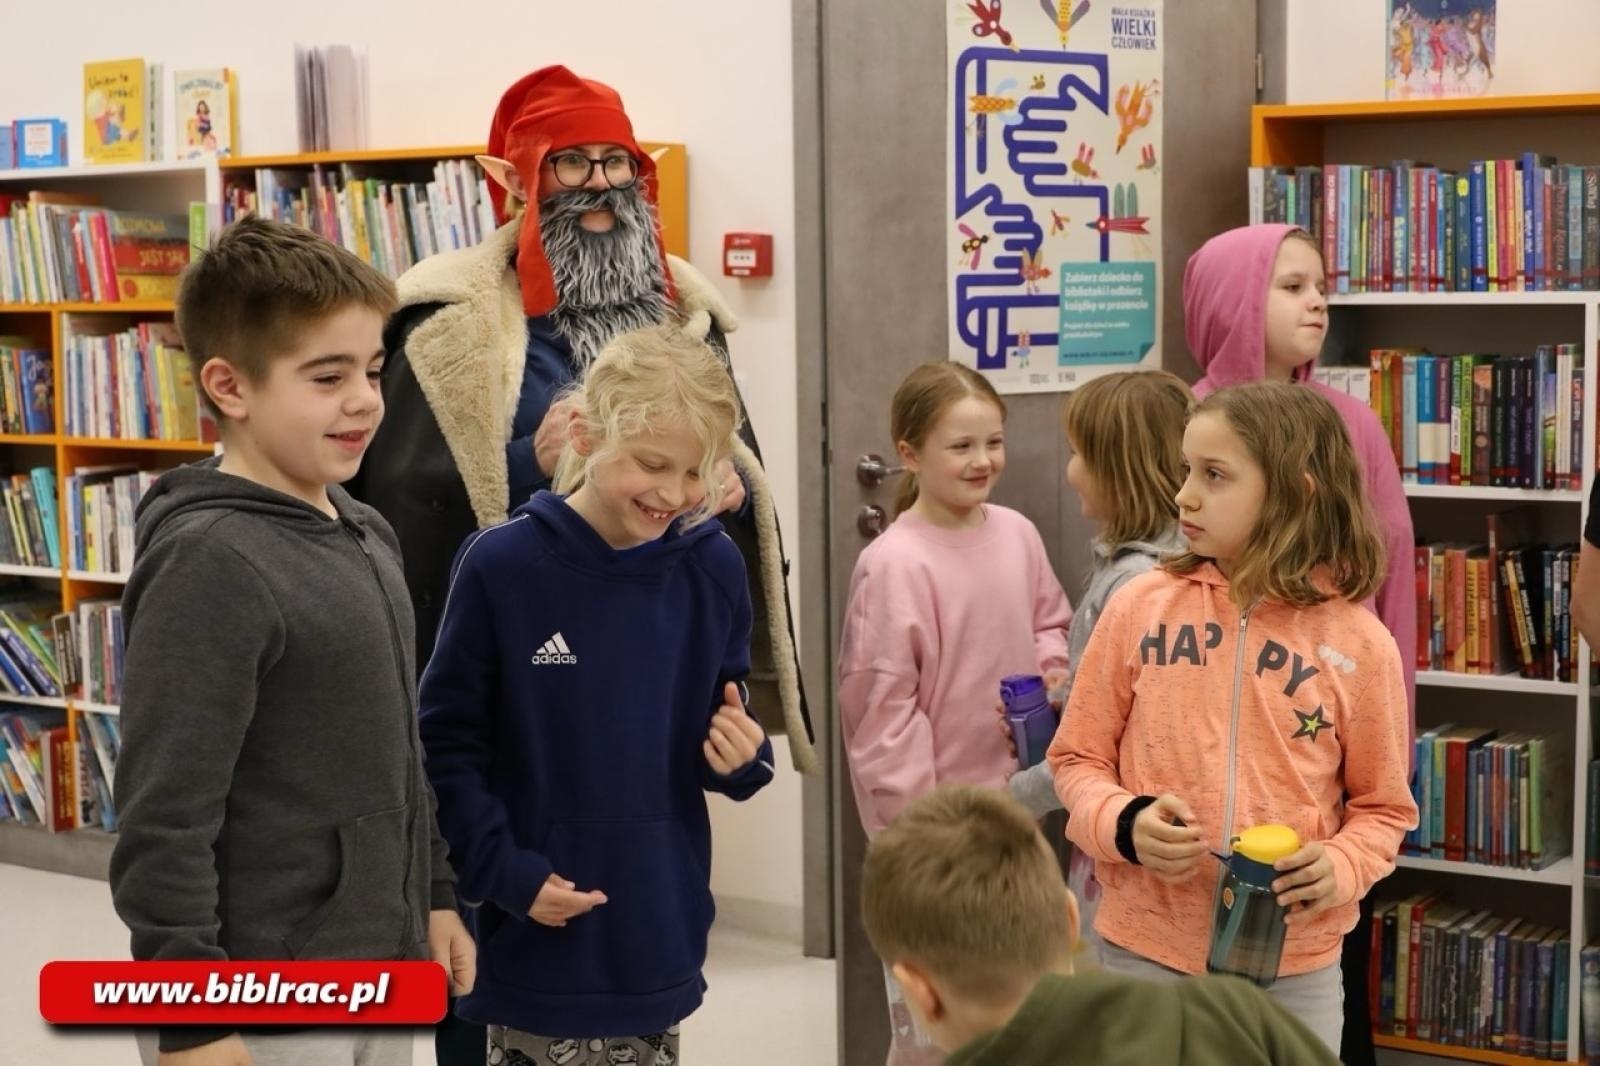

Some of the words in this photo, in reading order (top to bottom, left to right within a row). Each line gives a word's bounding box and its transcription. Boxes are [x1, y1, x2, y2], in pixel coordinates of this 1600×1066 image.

[1112, 18, 1156, 36] WIELKI
[1111, 36, 1156, 50] CZŁOWIEK
[1065, 272, 1097, 283] Zabierz
[1099, 271, 1132, 283] dziecko
[531, 653, 577, 665] adidas
